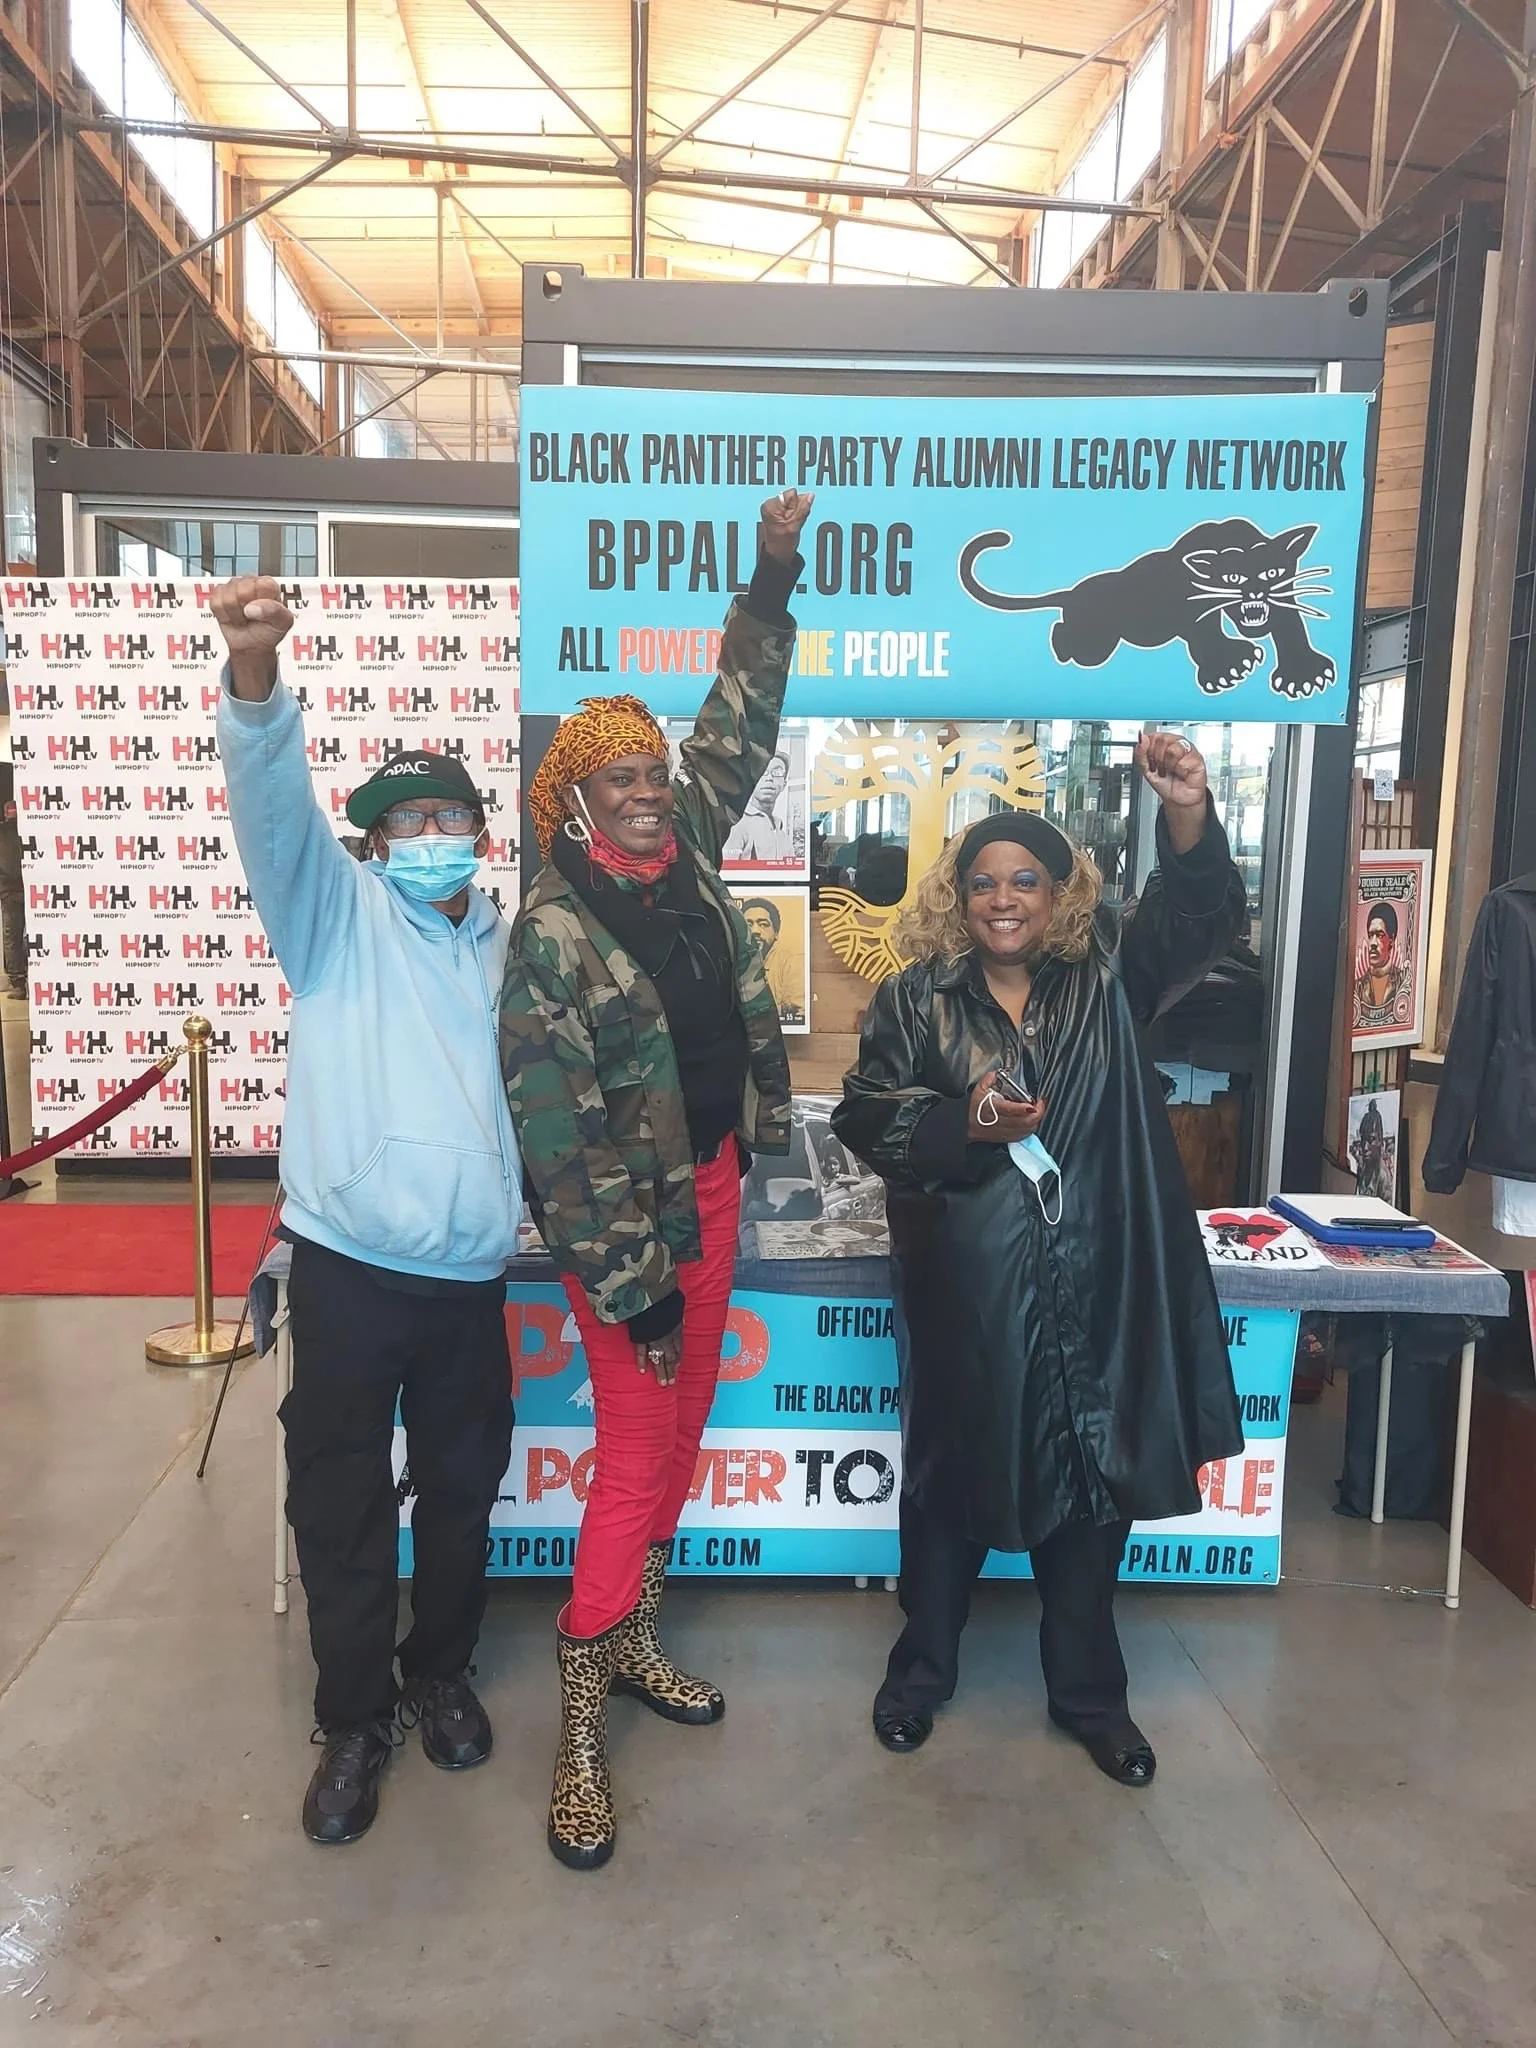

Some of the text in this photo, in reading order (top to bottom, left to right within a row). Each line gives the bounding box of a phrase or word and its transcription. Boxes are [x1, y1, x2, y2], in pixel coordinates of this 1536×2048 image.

[529, 432, 1348, 491] BLACK PANTHER PARTY ALUMNI LEGACY NETWORK
[588, 518, 914, 597] BPPAL.ORG
[558, 626, 951, 679] ALL POWER HE PEOPLE
[817, 1305, 895, 1338] OFFICIA
[774, 1384, 808, 1412] THE
[813, 1385, 873, 1414] BLACK
[795, 1449, 895, 1507] TO
[1127, 1544, 1254, 1575] PALN.ORG
